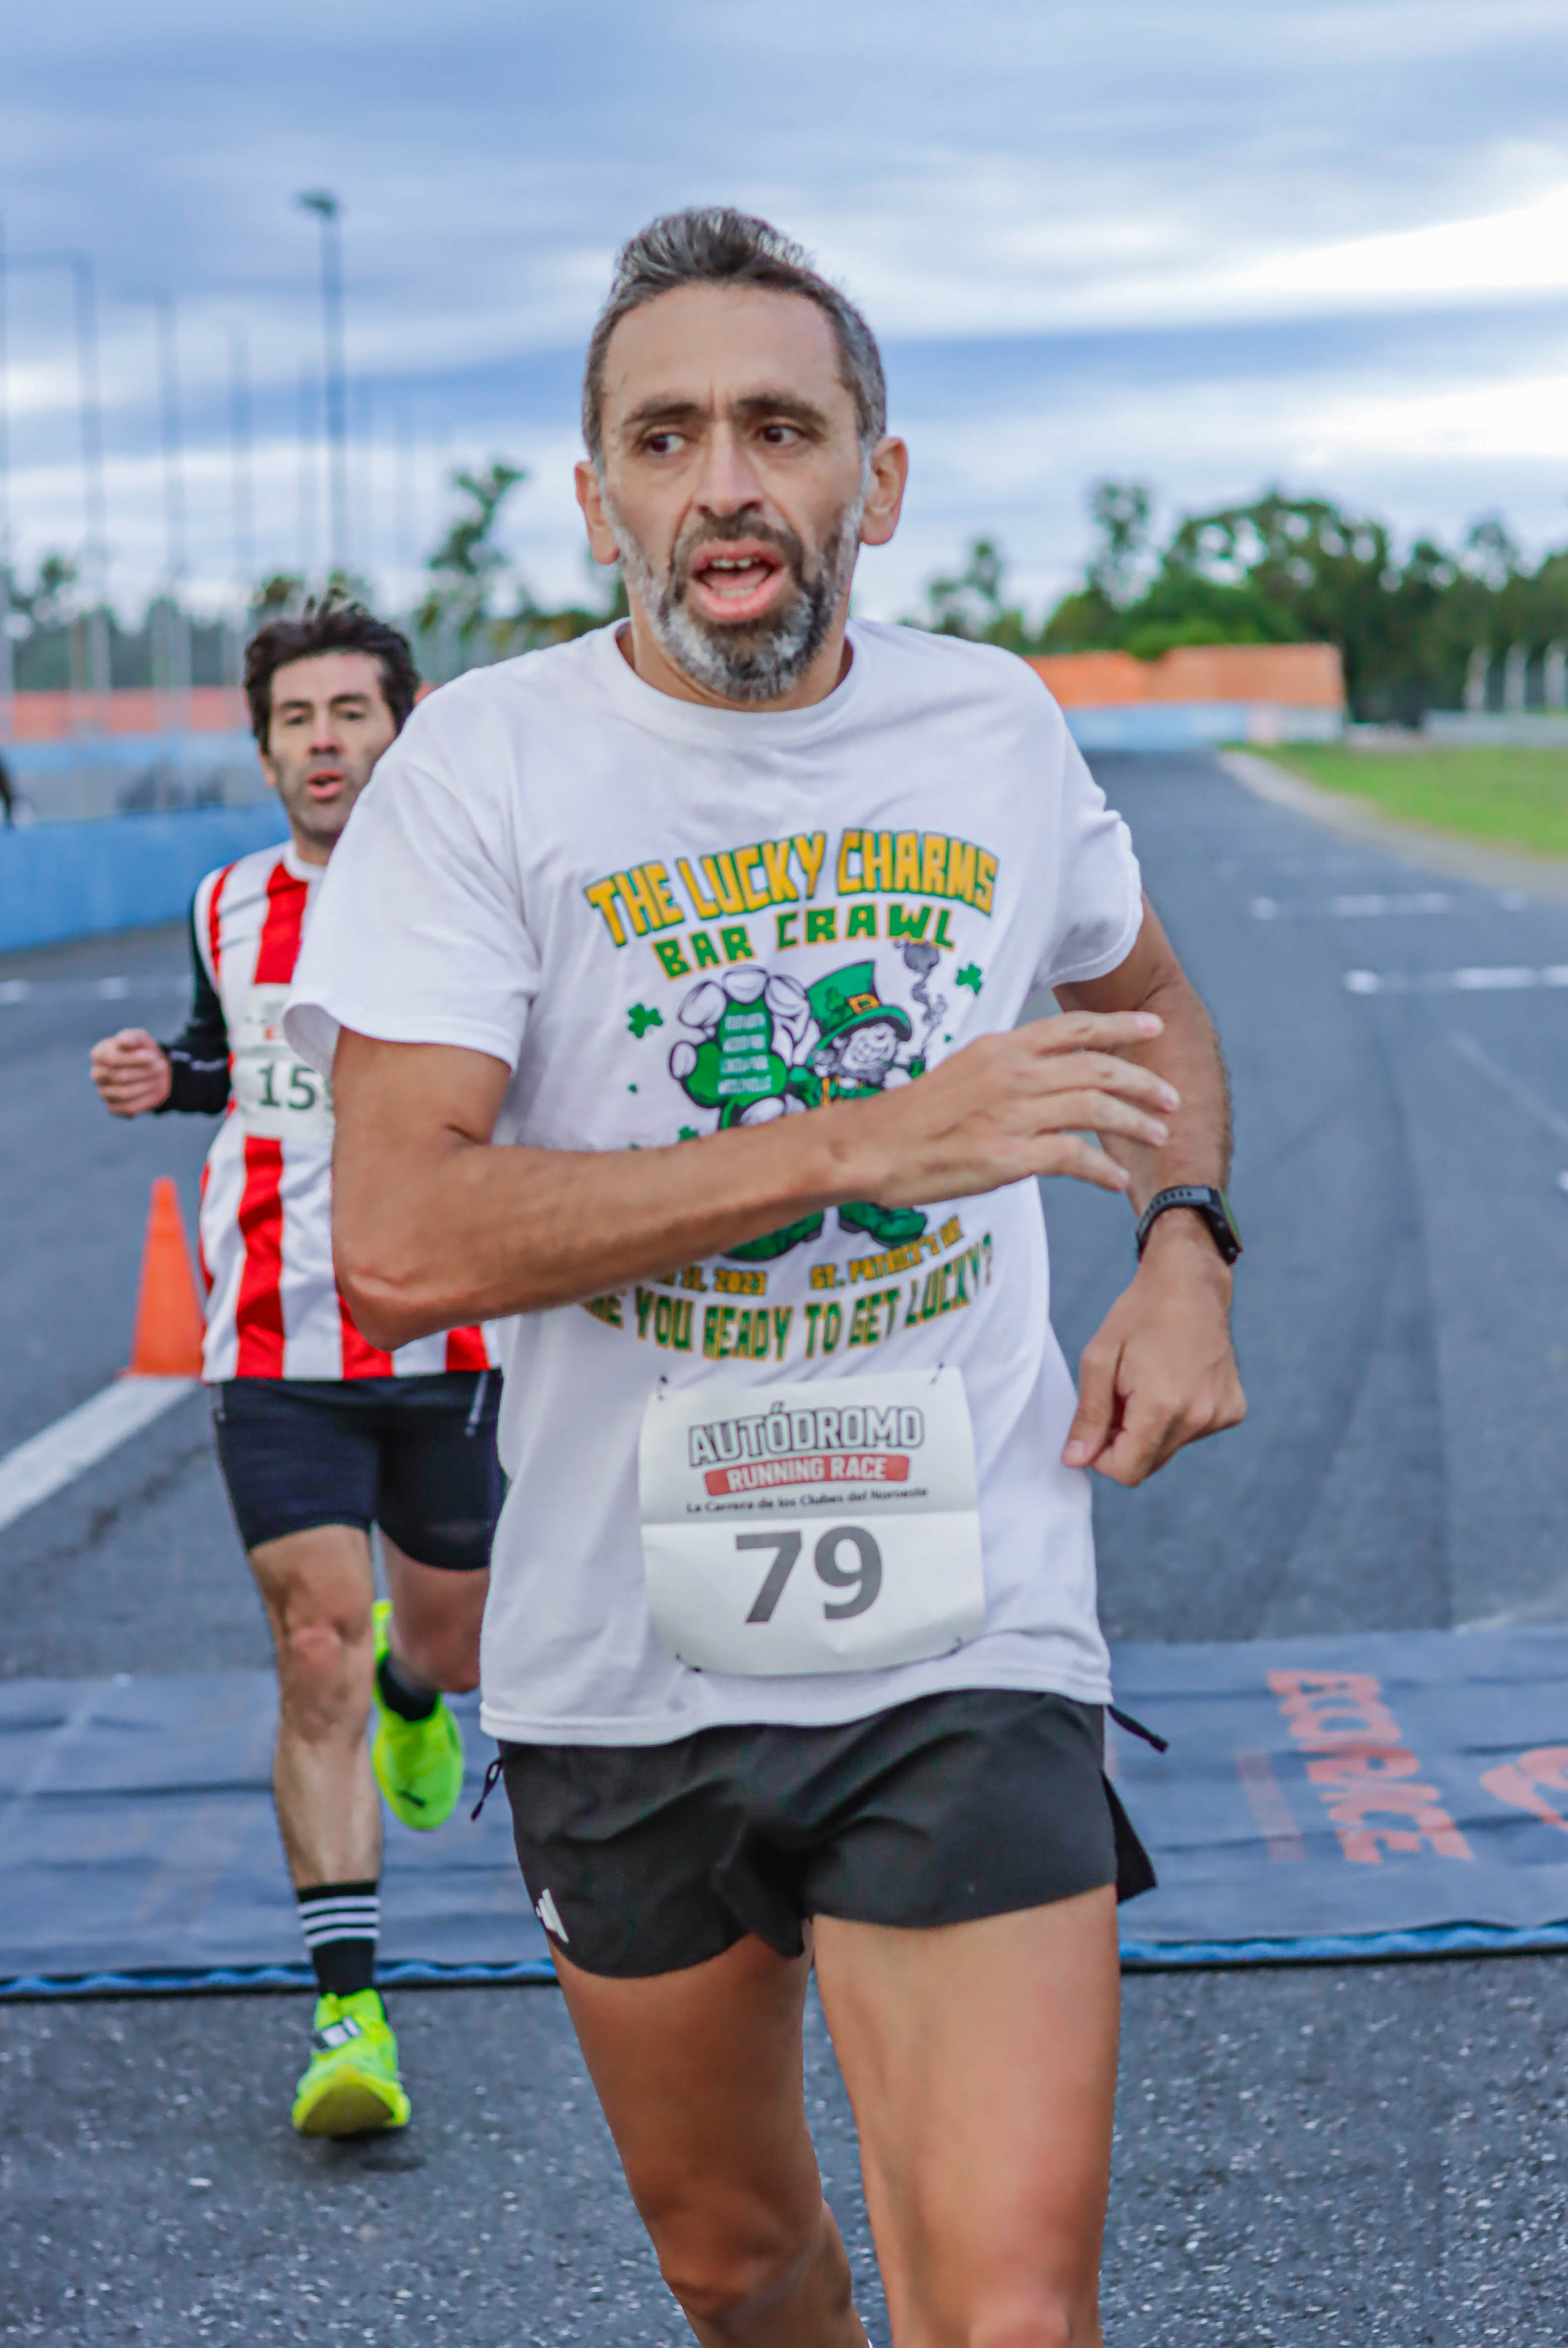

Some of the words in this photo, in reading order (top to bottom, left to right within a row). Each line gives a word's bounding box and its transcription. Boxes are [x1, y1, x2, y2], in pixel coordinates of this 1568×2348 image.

[584, 859, 685, 947] THE
[675, 831, 827, 920] LUCKY
[837, 828, 999, 918] CHARMS
[651, 925, 757, 981] BAR
[776, 903, 955, 952] CRAWL
[635, 1286, 695, 1352] YOU
[702, 1304, 794, 1361] READY
[805, 1300, 841, 1360] TO
[688, 1400, 925, 1467] AUTÓDROMO
[687, 1501, 701, 1512] La
[705, 1501, 754, 1511] Carrera
[757, 1497, 774, 1508] de
[726, 1457, 825, 1492] RUNNING
[830, 1456, 888, 1482] RACE
[736, 1524, 882, 1624] 79
